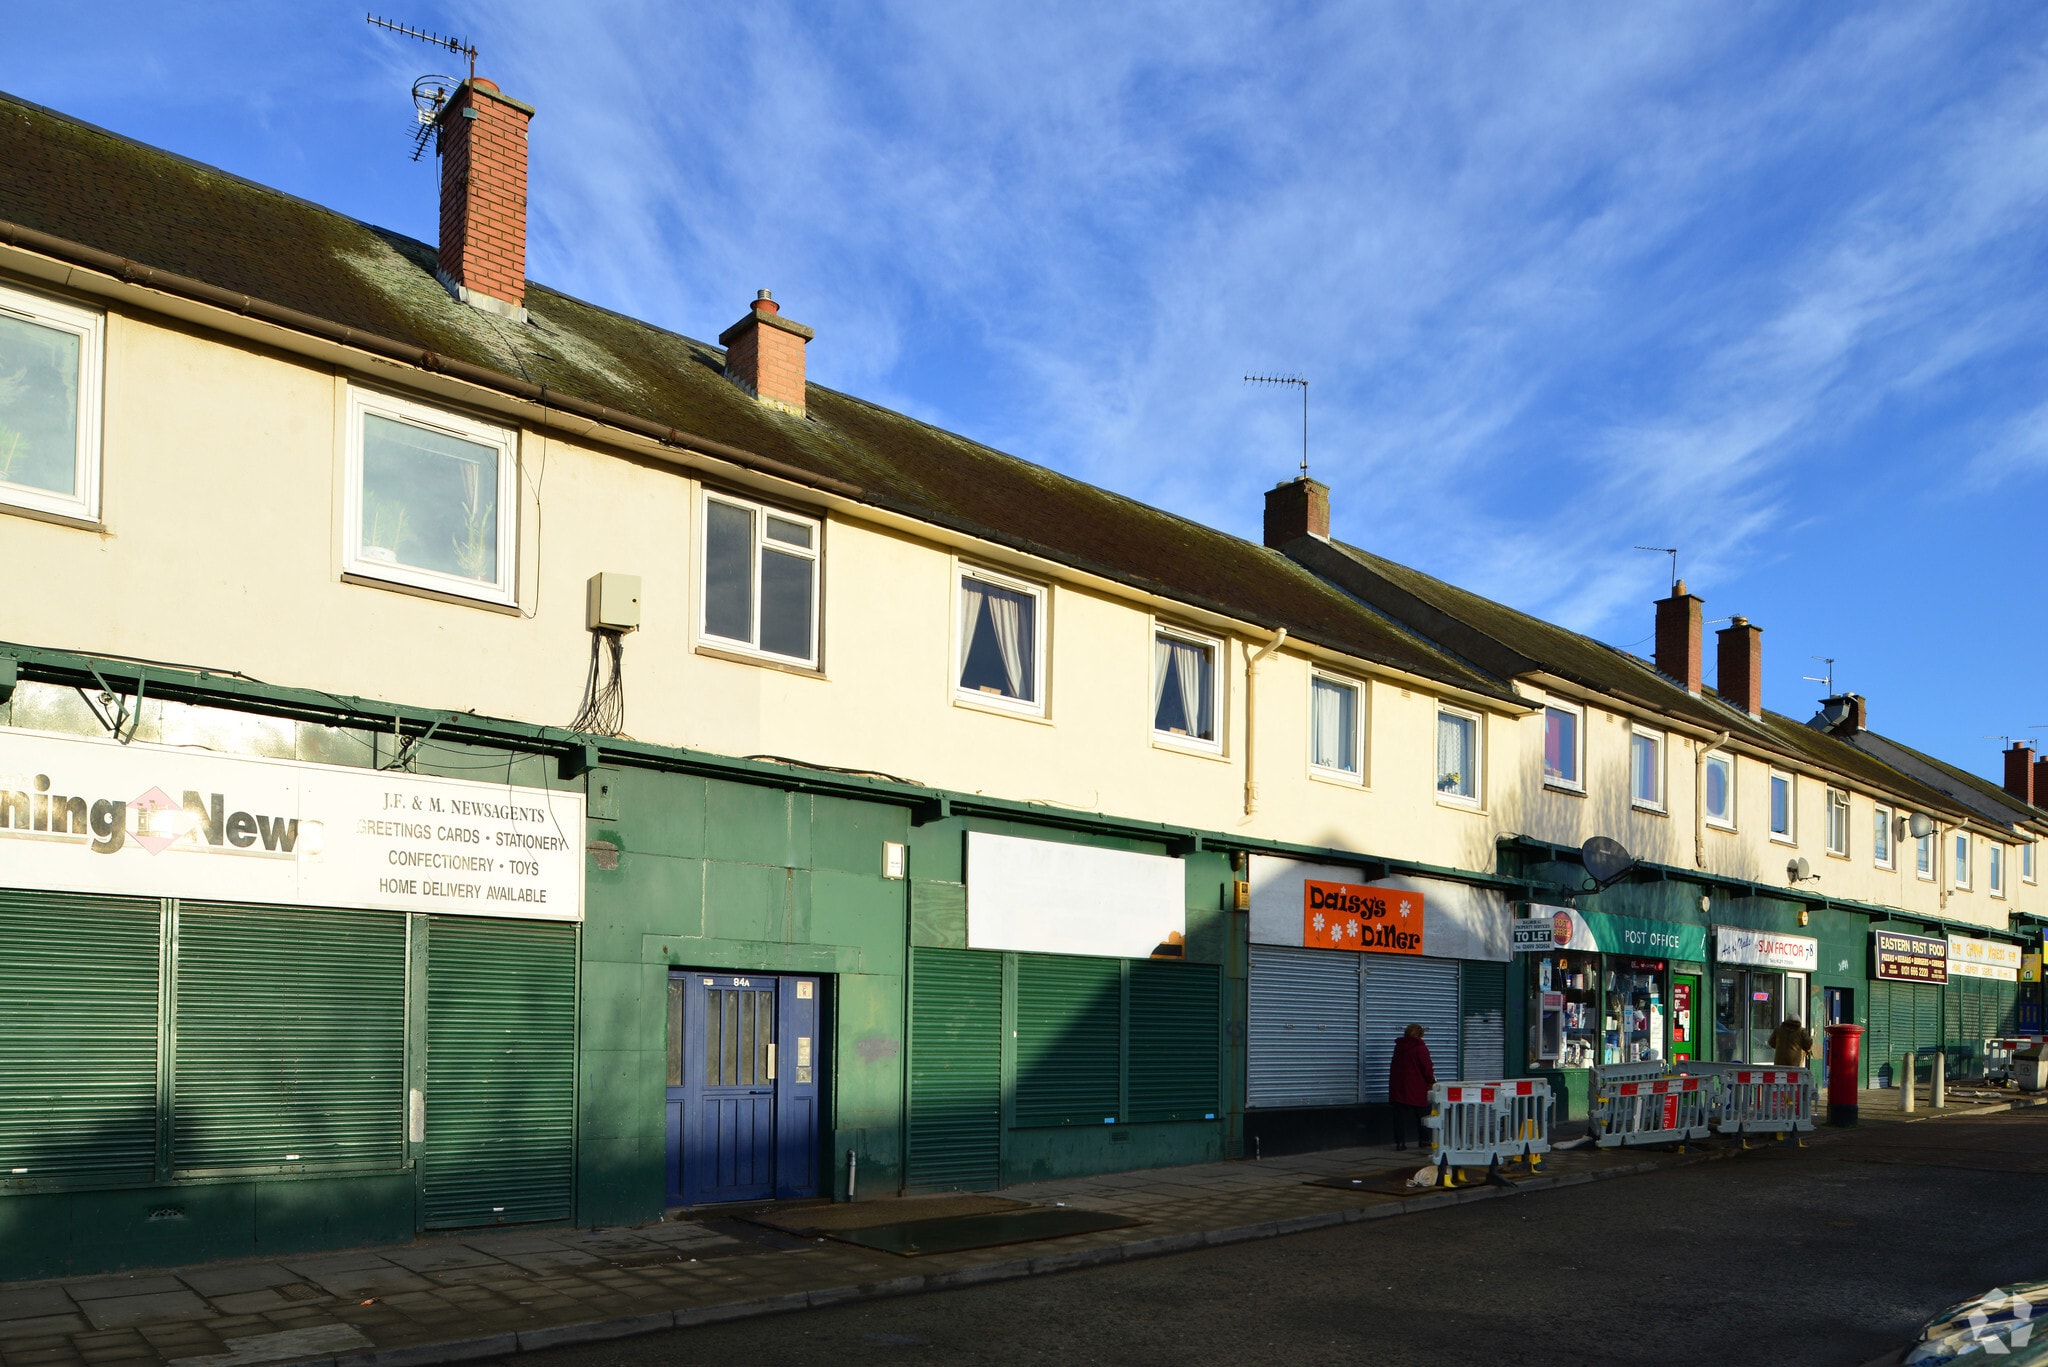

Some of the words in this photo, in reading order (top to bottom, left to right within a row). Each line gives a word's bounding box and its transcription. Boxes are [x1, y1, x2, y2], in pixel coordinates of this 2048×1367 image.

[383, 792, 405, 811] J.F.
[412, 796, 422, 810] &
[429, 798, 445, 812] M.
[451, 799, 545, 823] NEWSAGENTS
[356, 819, 431, 840] GREETINGS
[437, 826, 480, 844] CARDS
[496, 831, 565, 851] STATIONERY
[388, 850, 494, 872] CONFECTIONERY
[509, 860, 539, 876] TOYS
[379, 878, 417, 895] HOME
[423, 881, 481, 899] DELIVERY
[487, 886, 547, 904] AVAILABLE
[1310, 885, 1386, 920] Daisy's
[1516, 931, 1529, 941] TO
[1532, 930, 1550, 941] LET
[1625, 930, 1647, 944] POST
[1649, 932, 1679, 948] OFFICE
[1880, 936, 1910, 953] EASTERN
[1912, 940, 1927, 955] FAST
[1929, 943, 1945, 957] FOOD
[1758, 939, 1773, 954] SUN
[1774, 942, 1804, 957] FACTOR
[733, 977, 750, 987] 84A
